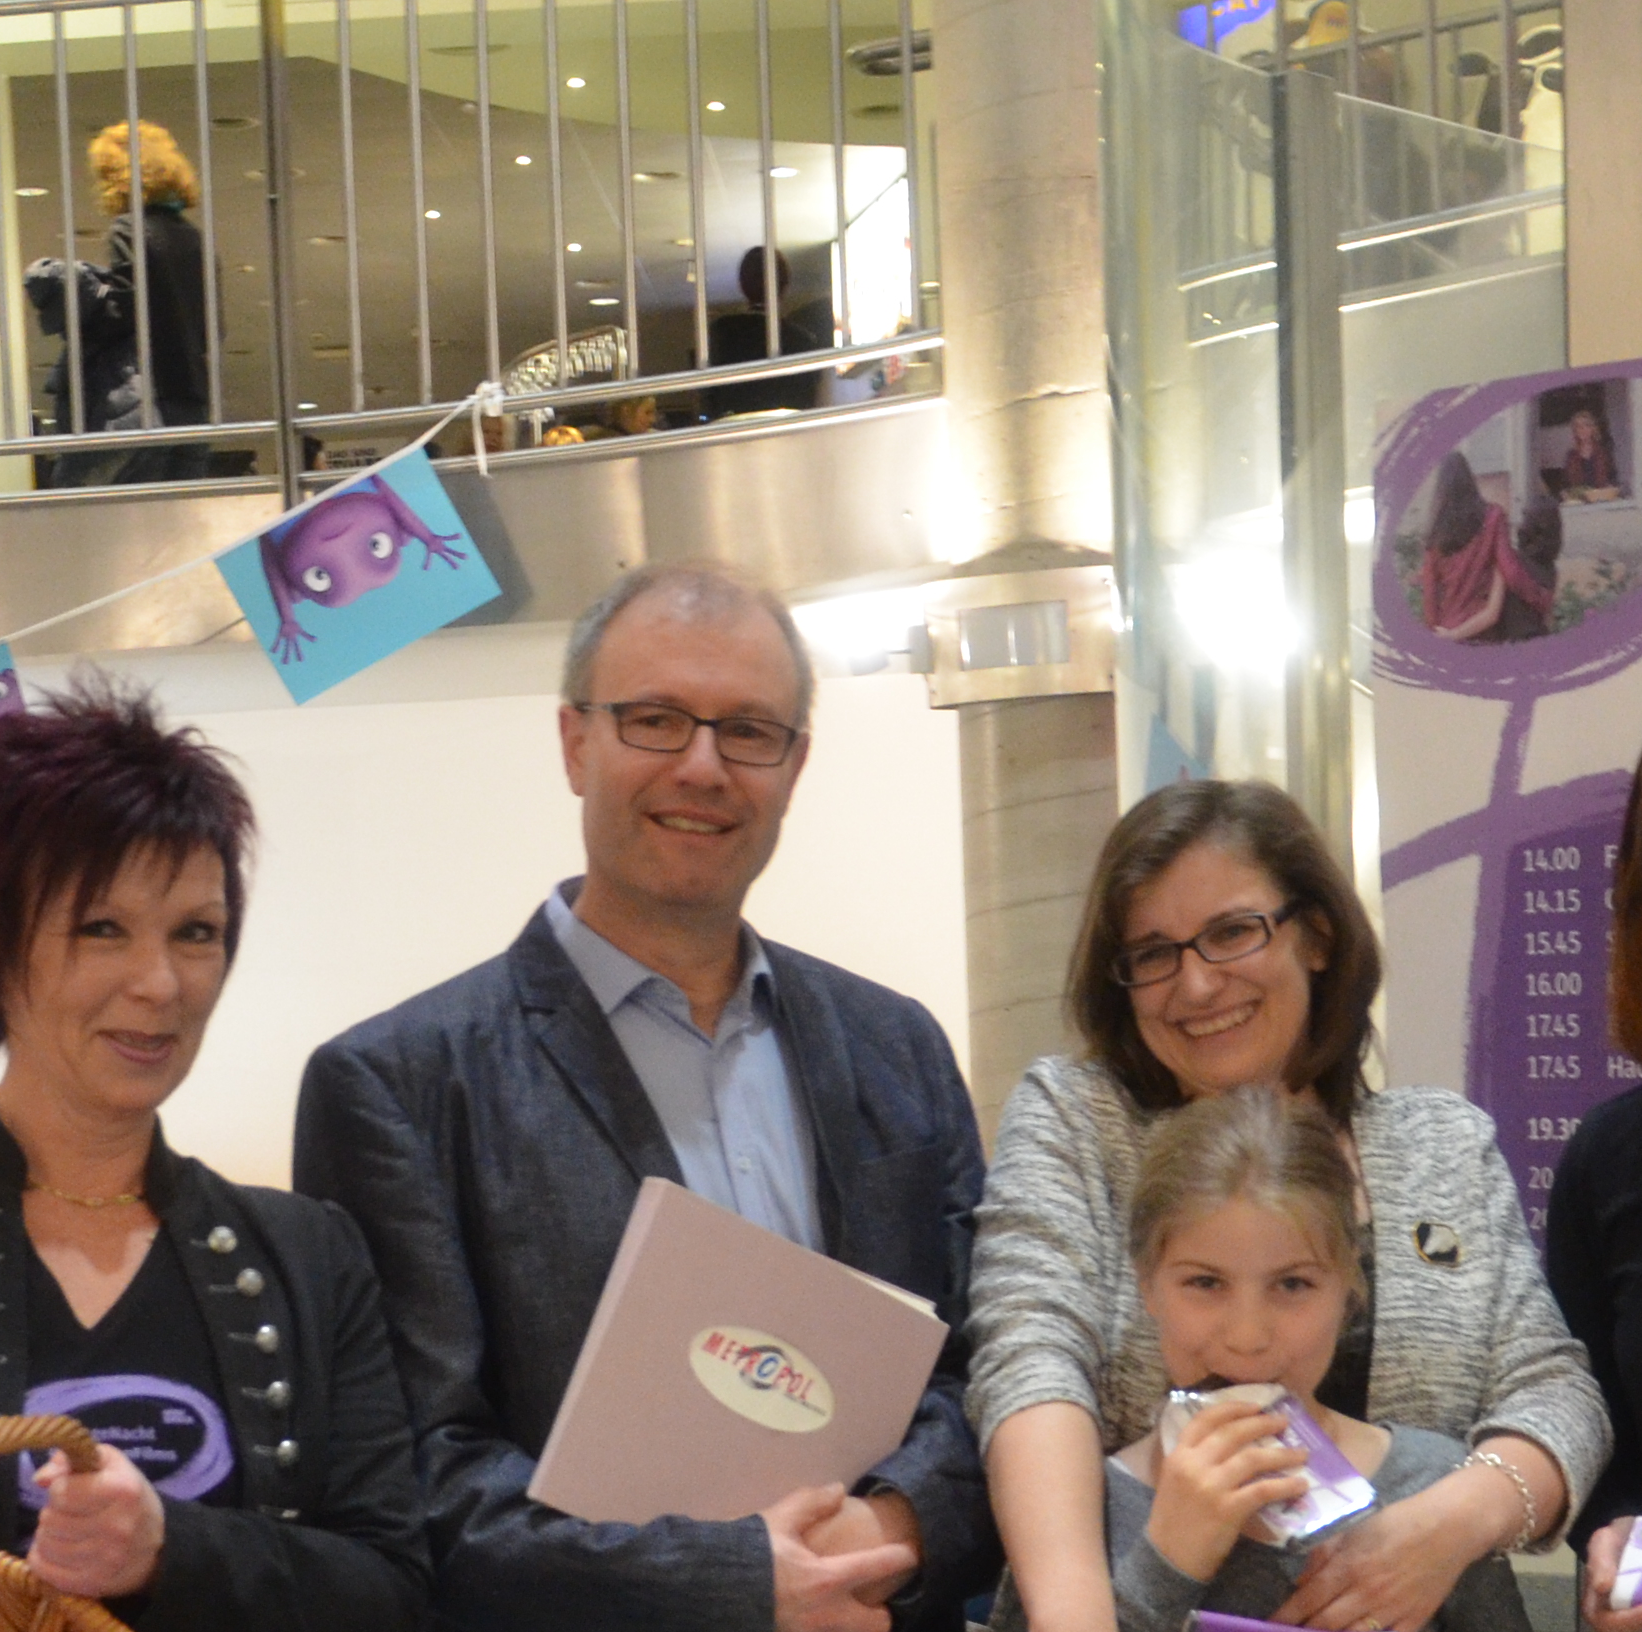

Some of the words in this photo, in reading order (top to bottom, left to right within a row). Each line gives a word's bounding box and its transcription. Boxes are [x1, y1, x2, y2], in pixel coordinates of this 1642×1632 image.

[1523, 846, 1581, 873] 14.00
[1523, 889, 1581, 915] 14.15
[1525, 931, 1582, 956] 15.45
[1525, 973, 1583, 998] 16.00
[702, 1331, 817, 1402] METROPOL
